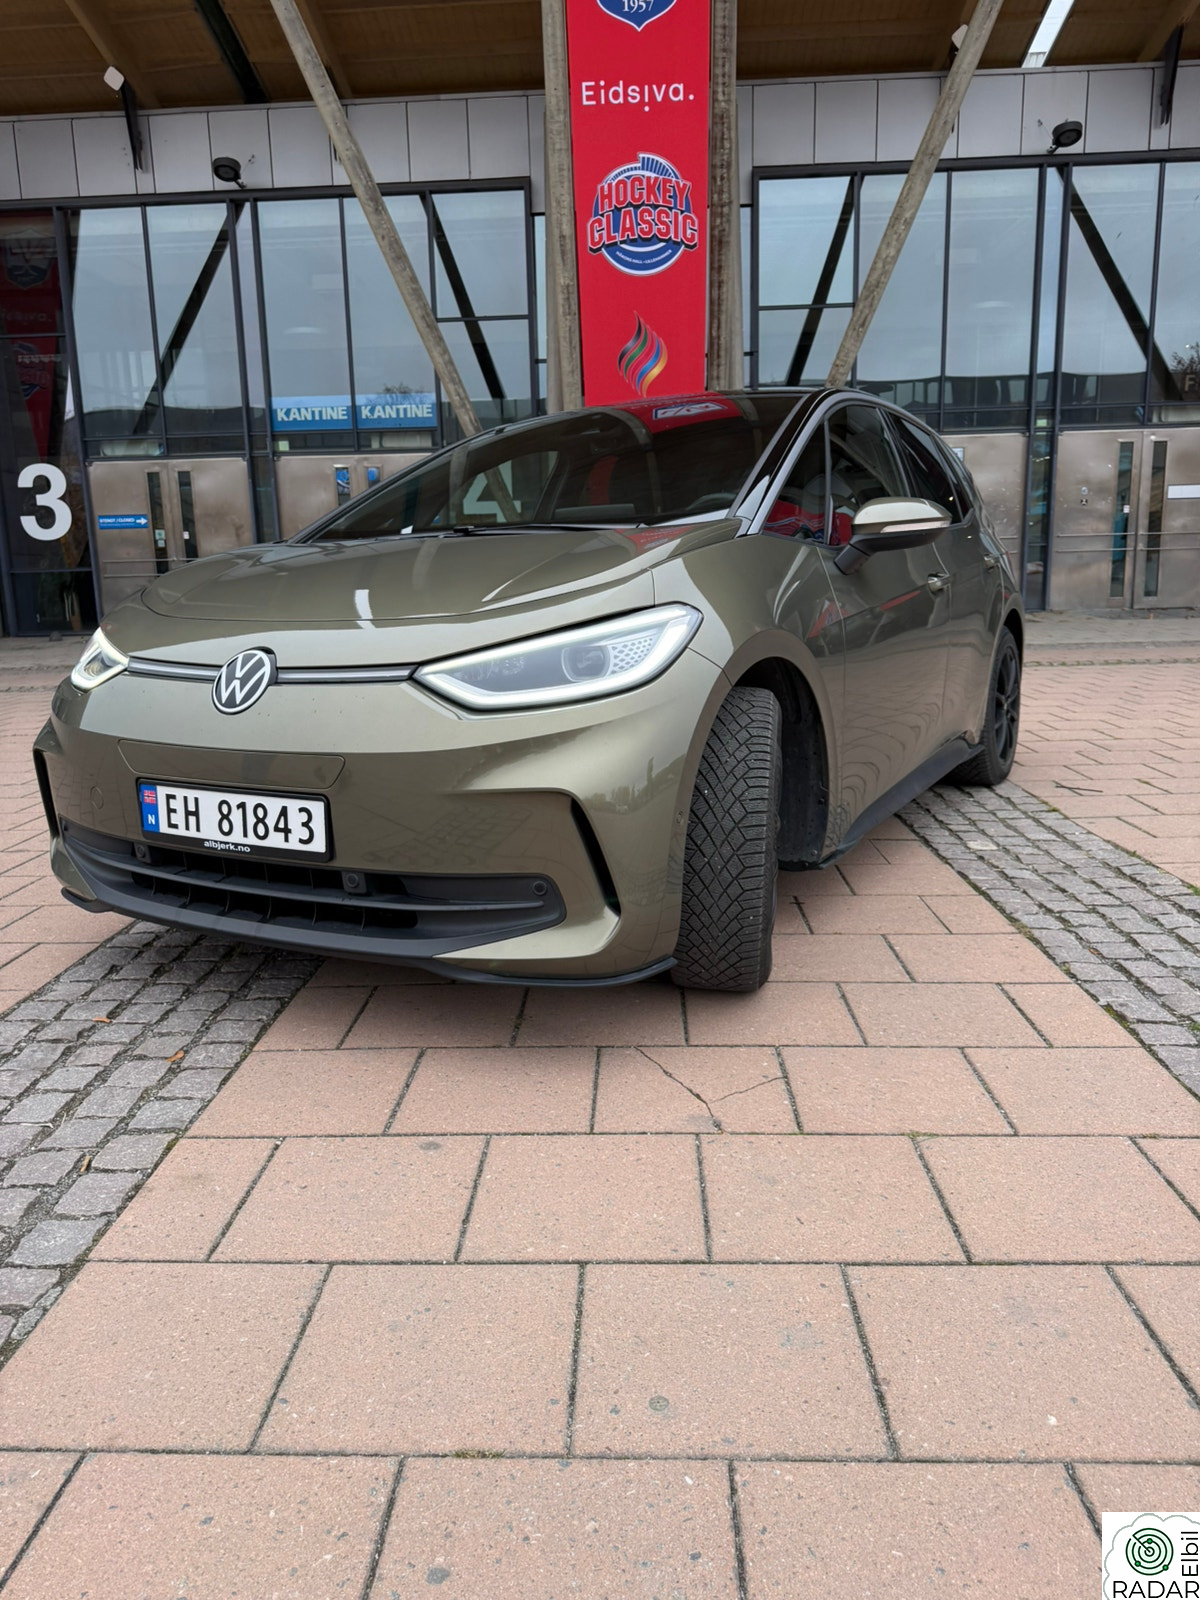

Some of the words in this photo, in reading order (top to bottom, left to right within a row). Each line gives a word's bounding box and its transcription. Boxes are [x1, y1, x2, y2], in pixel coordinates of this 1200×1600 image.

[622, 0, 654, 13] 1957
[598, 175, 692, 213] HOCKEY
[588, 206, 698, 251] CLASSIC
[277, 406, 348, 421] KANTINE
[361, 404, 433, 419] KANTINE
[17, 463, 73, 541] 3
[147, 814, 155, 825] N
[165, 793, 201, 833] EH
[217, 799, 315, 845] 81843
[204, 840, 251, 853] albjerk.no
